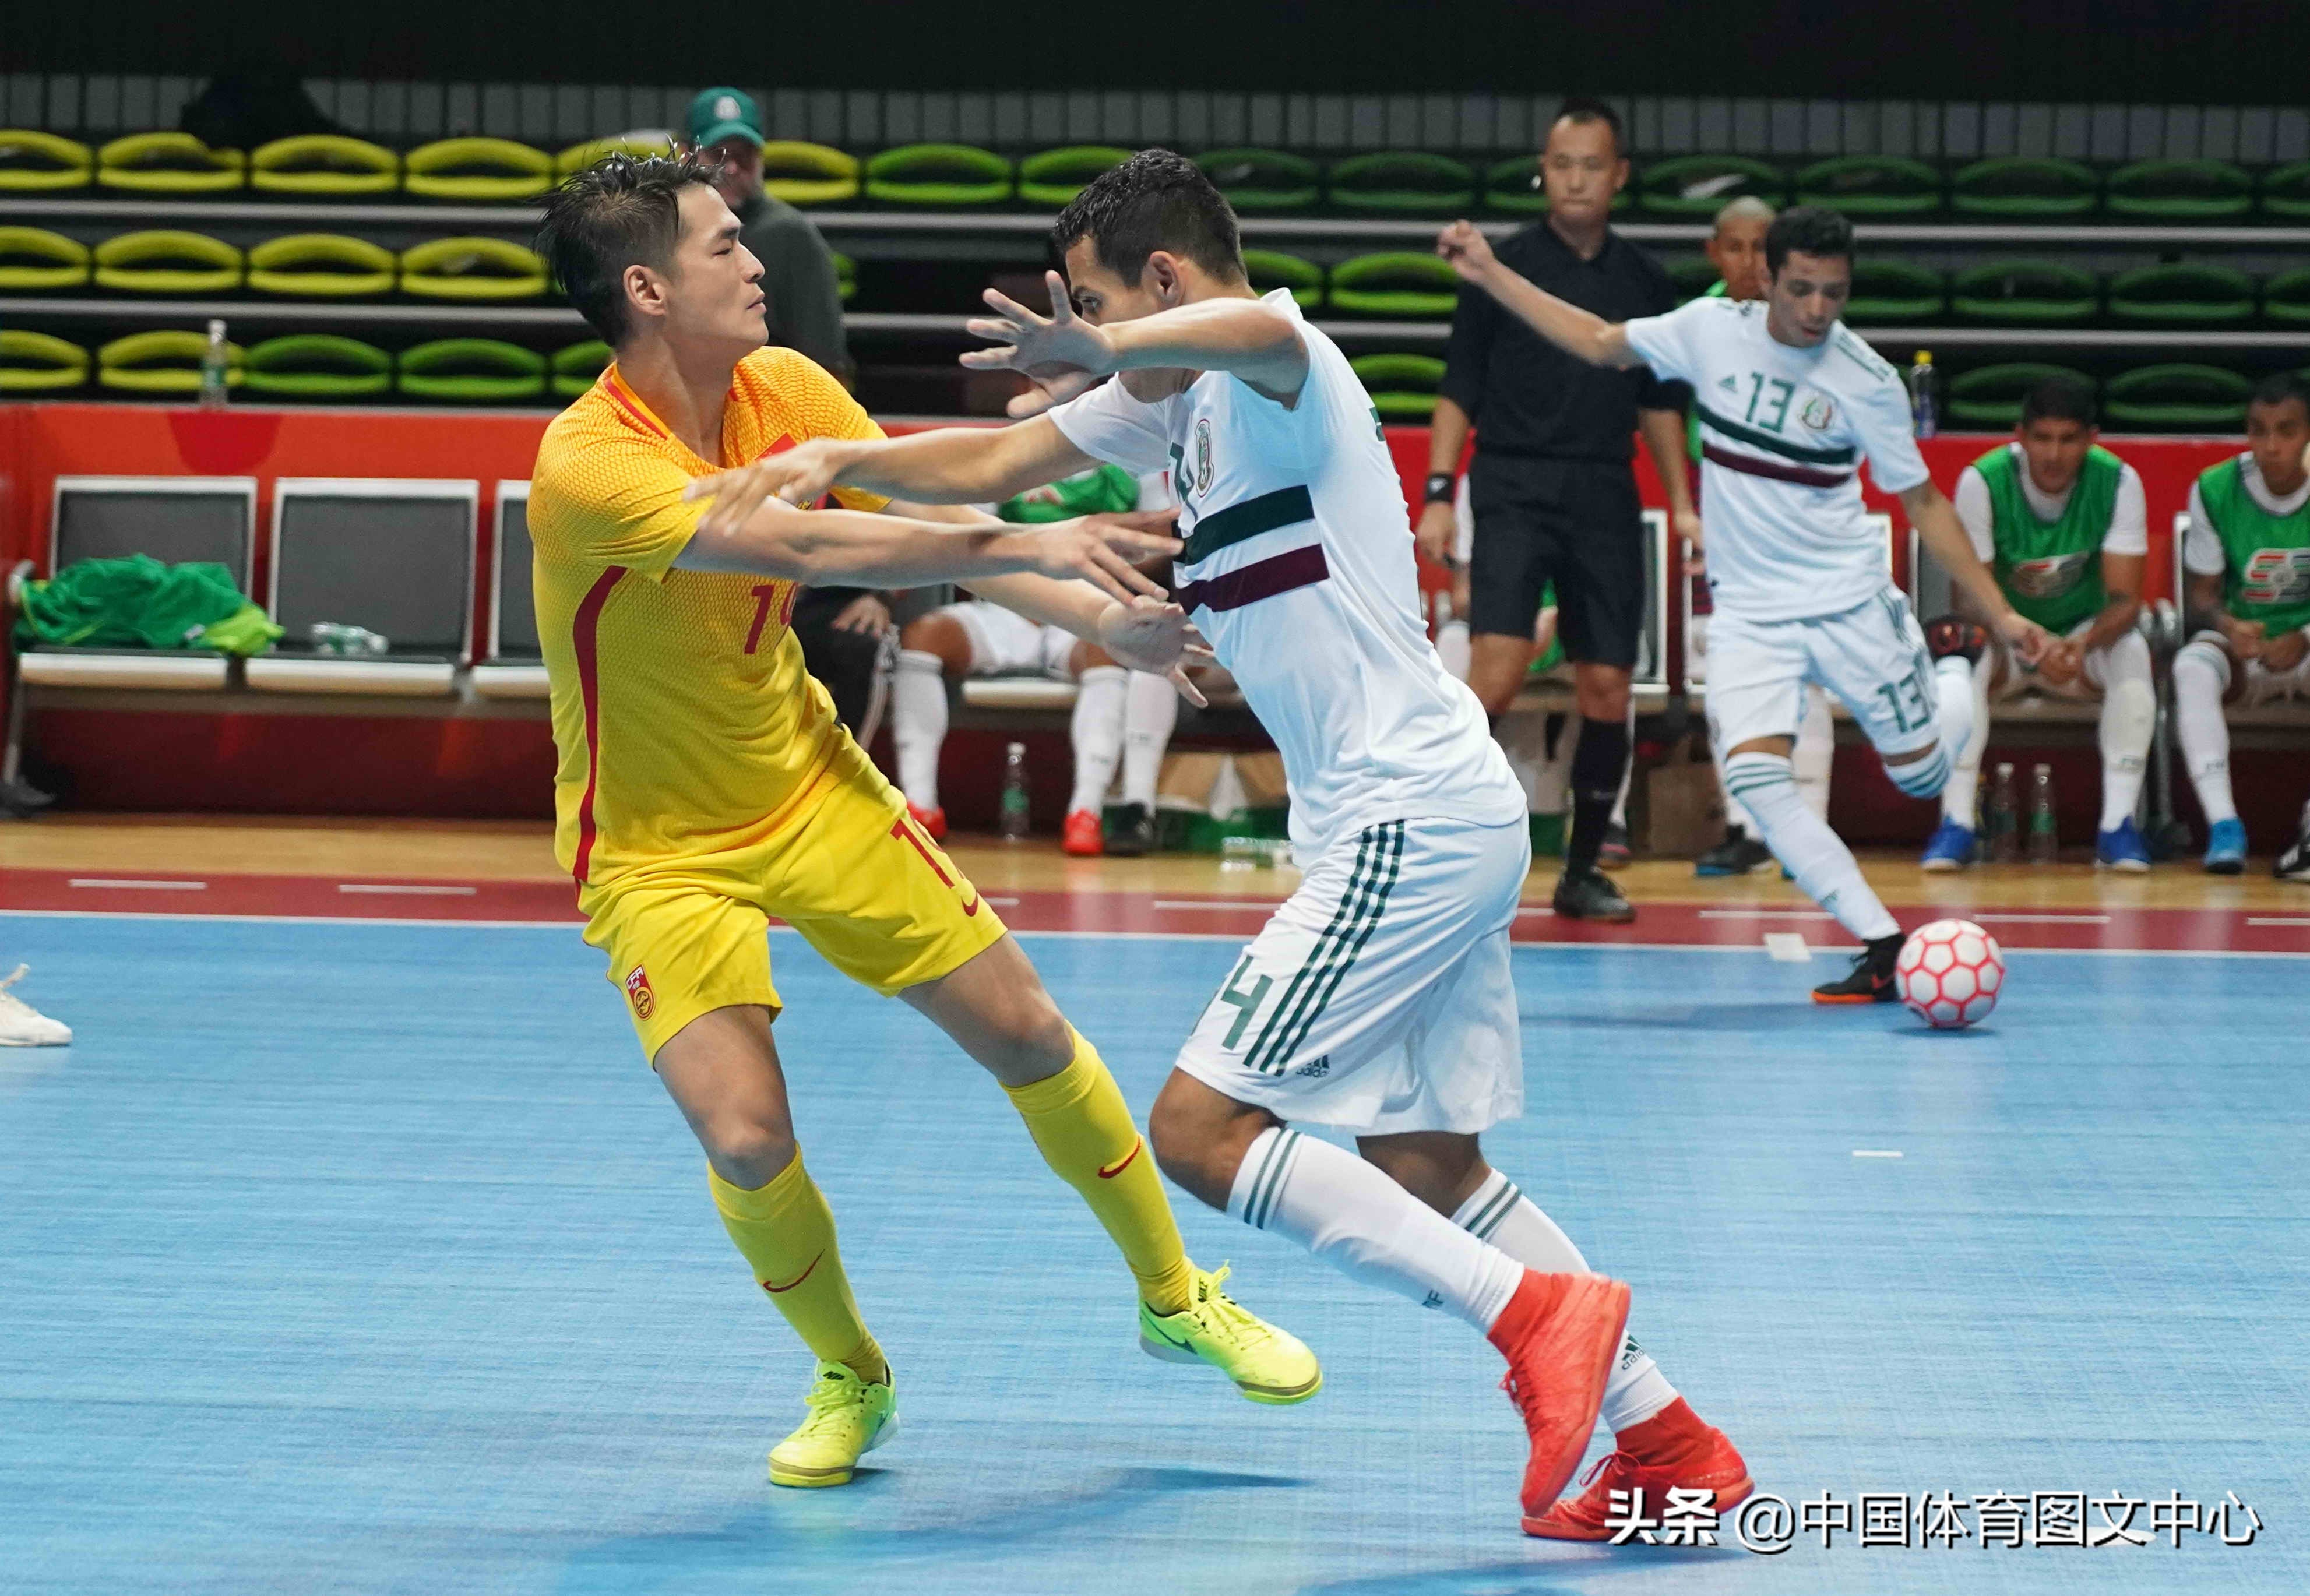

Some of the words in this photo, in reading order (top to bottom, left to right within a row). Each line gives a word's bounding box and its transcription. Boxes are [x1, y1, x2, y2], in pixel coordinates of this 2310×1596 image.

[1745, 372, 1795, 432] 13
[1877, 653, 1938, 732] 13
[626, 966, 644, 990] CFA
